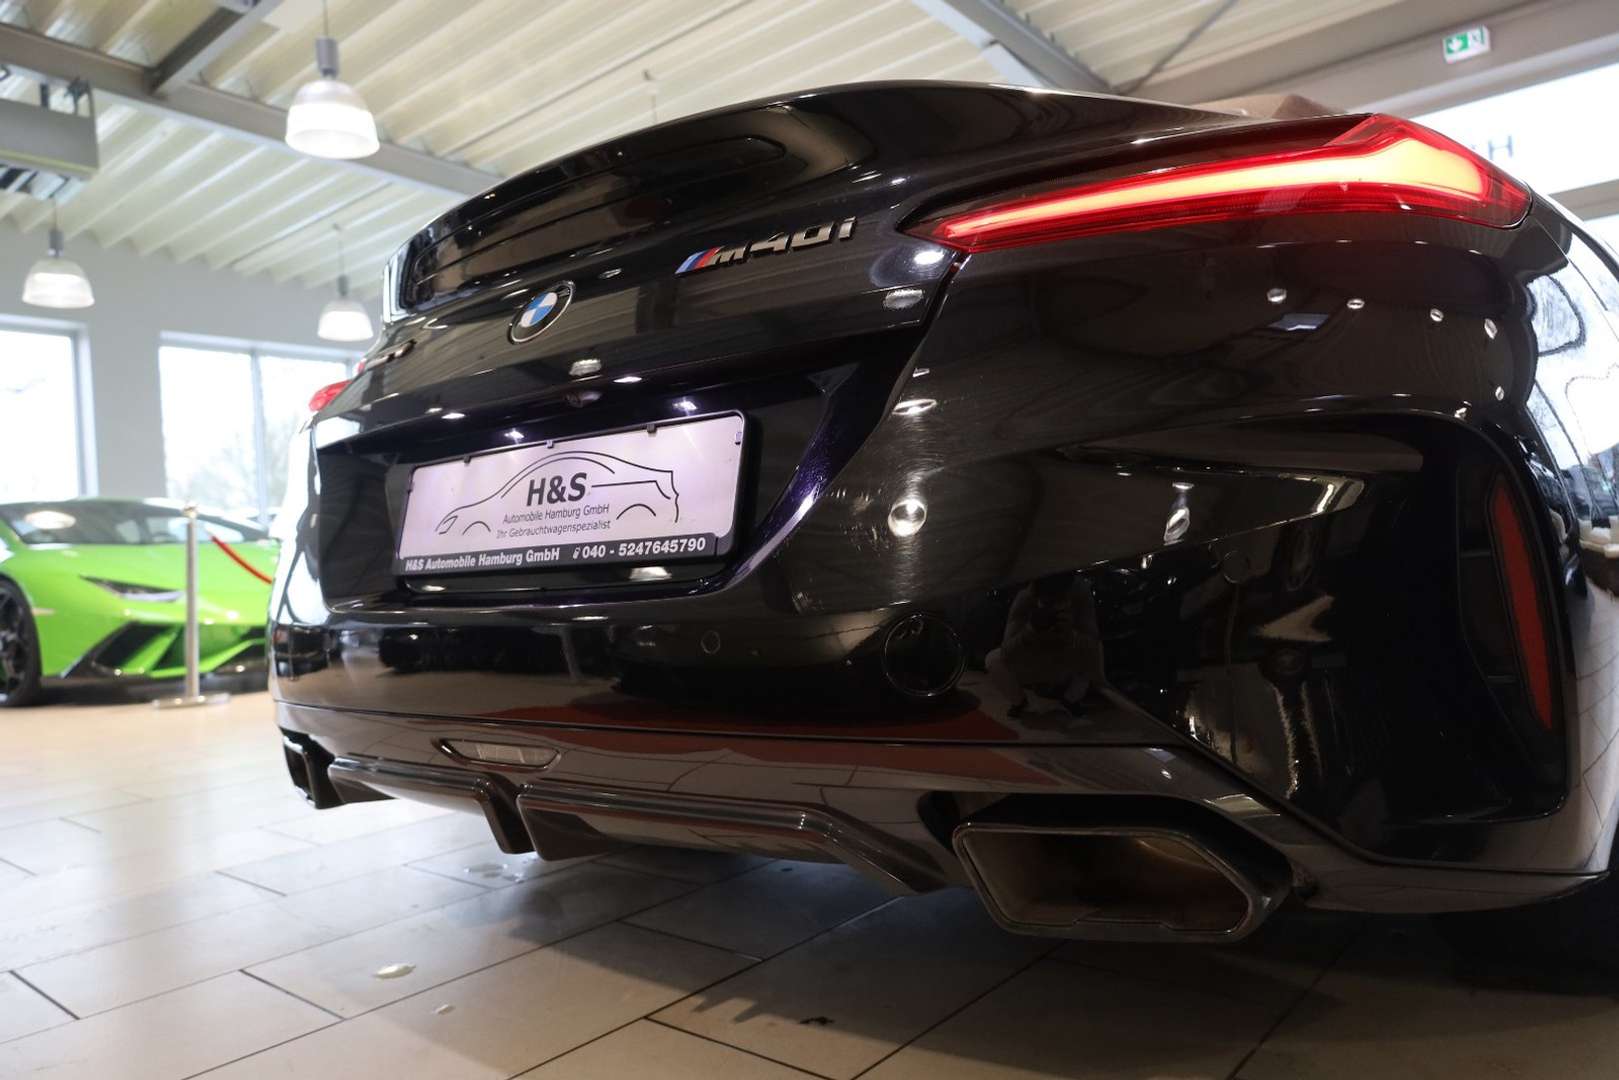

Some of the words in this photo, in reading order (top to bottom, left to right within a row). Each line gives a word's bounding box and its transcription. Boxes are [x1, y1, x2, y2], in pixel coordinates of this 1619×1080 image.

[527, 472, 588, 507] H&S
[503, 512, 544, 524] Automobile
[545, 508, 581, 520] Hamburg
[583, 504, 610, 516] GmbH
[496, 529, 508, 539] Ihr
[509, 520, 611, 537] Gebrauchtwagenspezialist
[405, 559, 424, 572] H&S
[426, 554, 476, 570] Automobile
[478, 551, 523, 567] Hamburg
[525, 548, 560, 563] GmbH
[583, 545, 606, 560] 040
[618, 537, 706, 557] 5247645790
